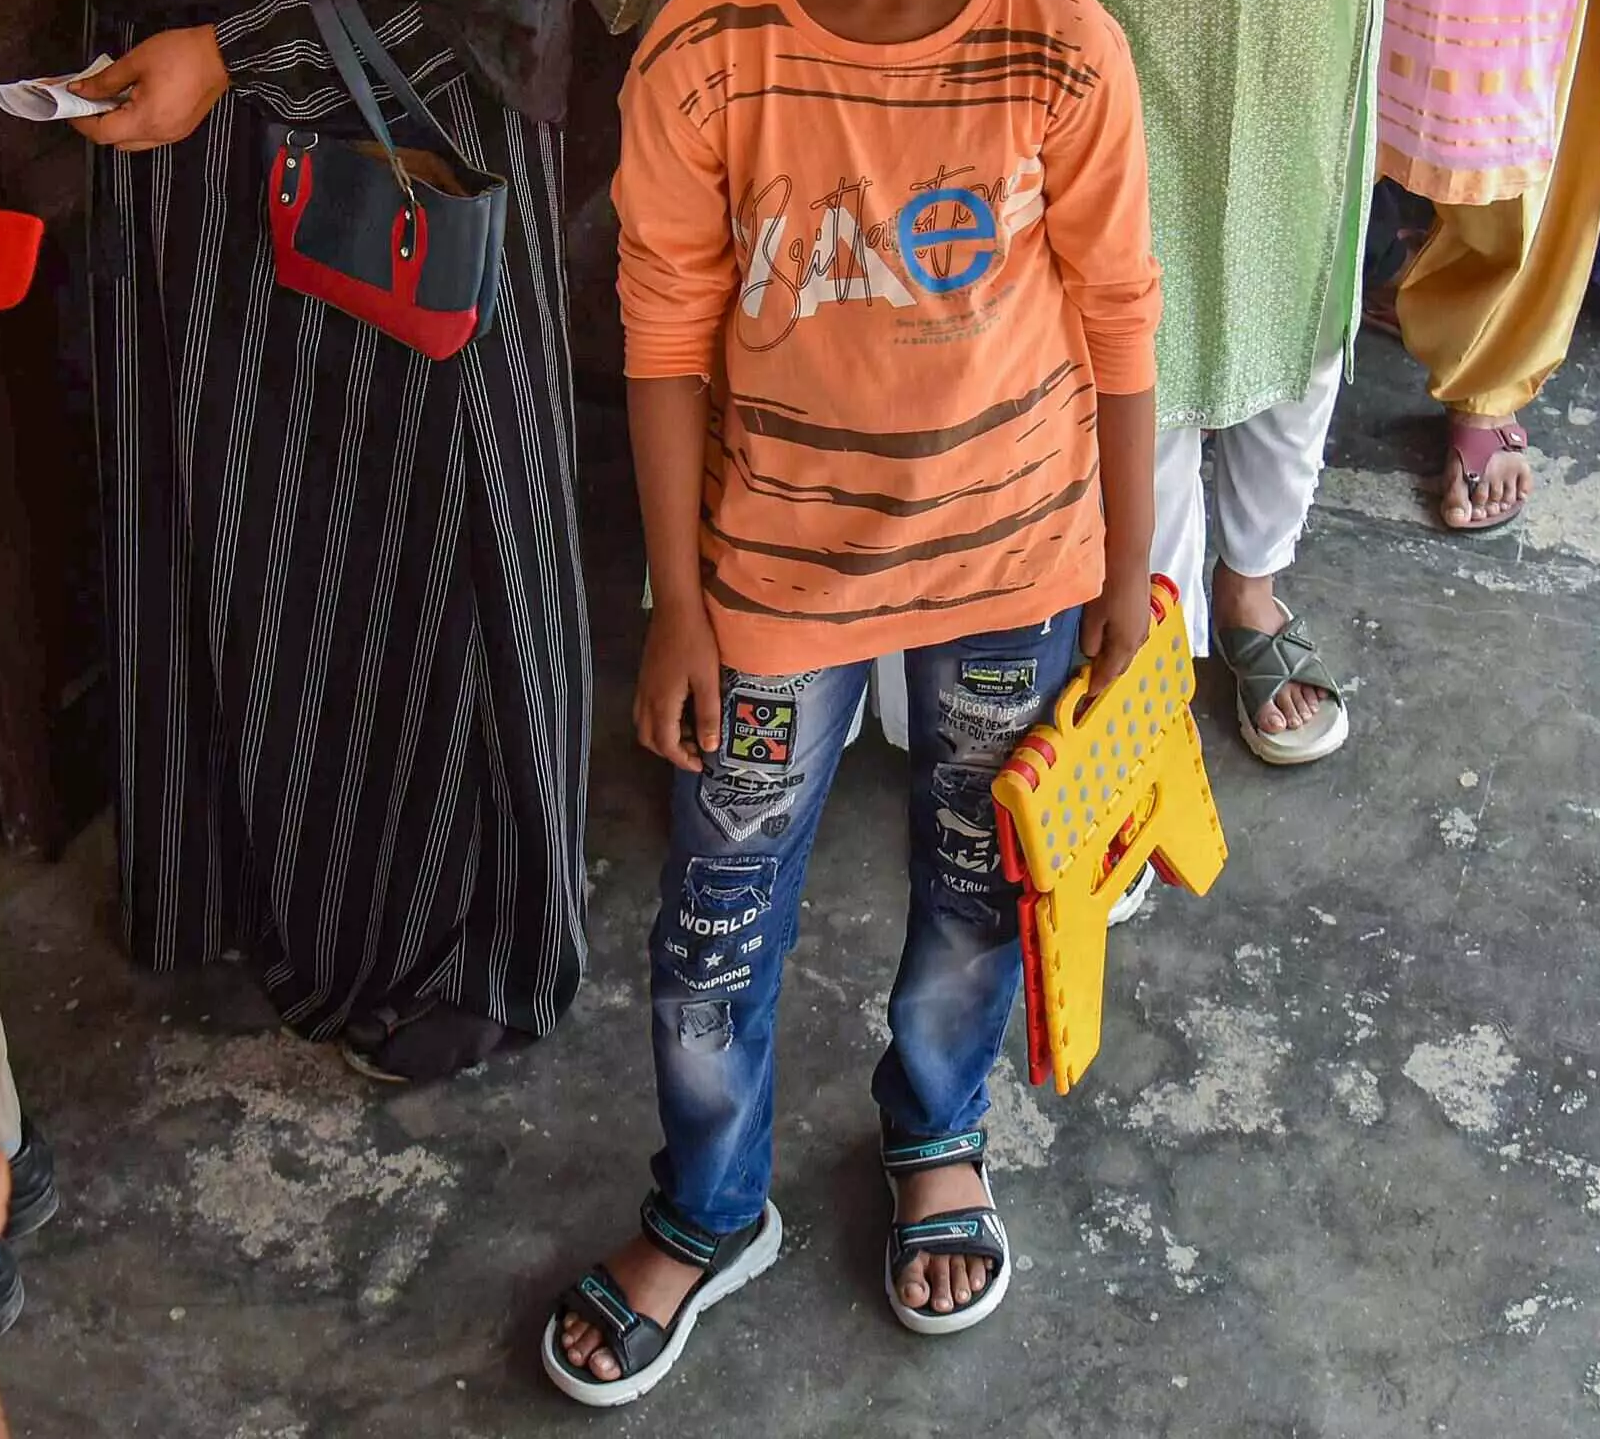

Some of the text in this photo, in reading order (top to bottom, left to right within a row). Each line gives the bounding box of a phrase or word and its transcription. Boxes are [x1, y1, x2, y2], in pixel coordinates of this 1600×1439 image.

[738, 725, 784, 738] OFF WHITE
[679, 907, 758, 936] WORLD
[740, 934, 763, 954] 15
[673, 964, 751, 991] CHAMPIONS
